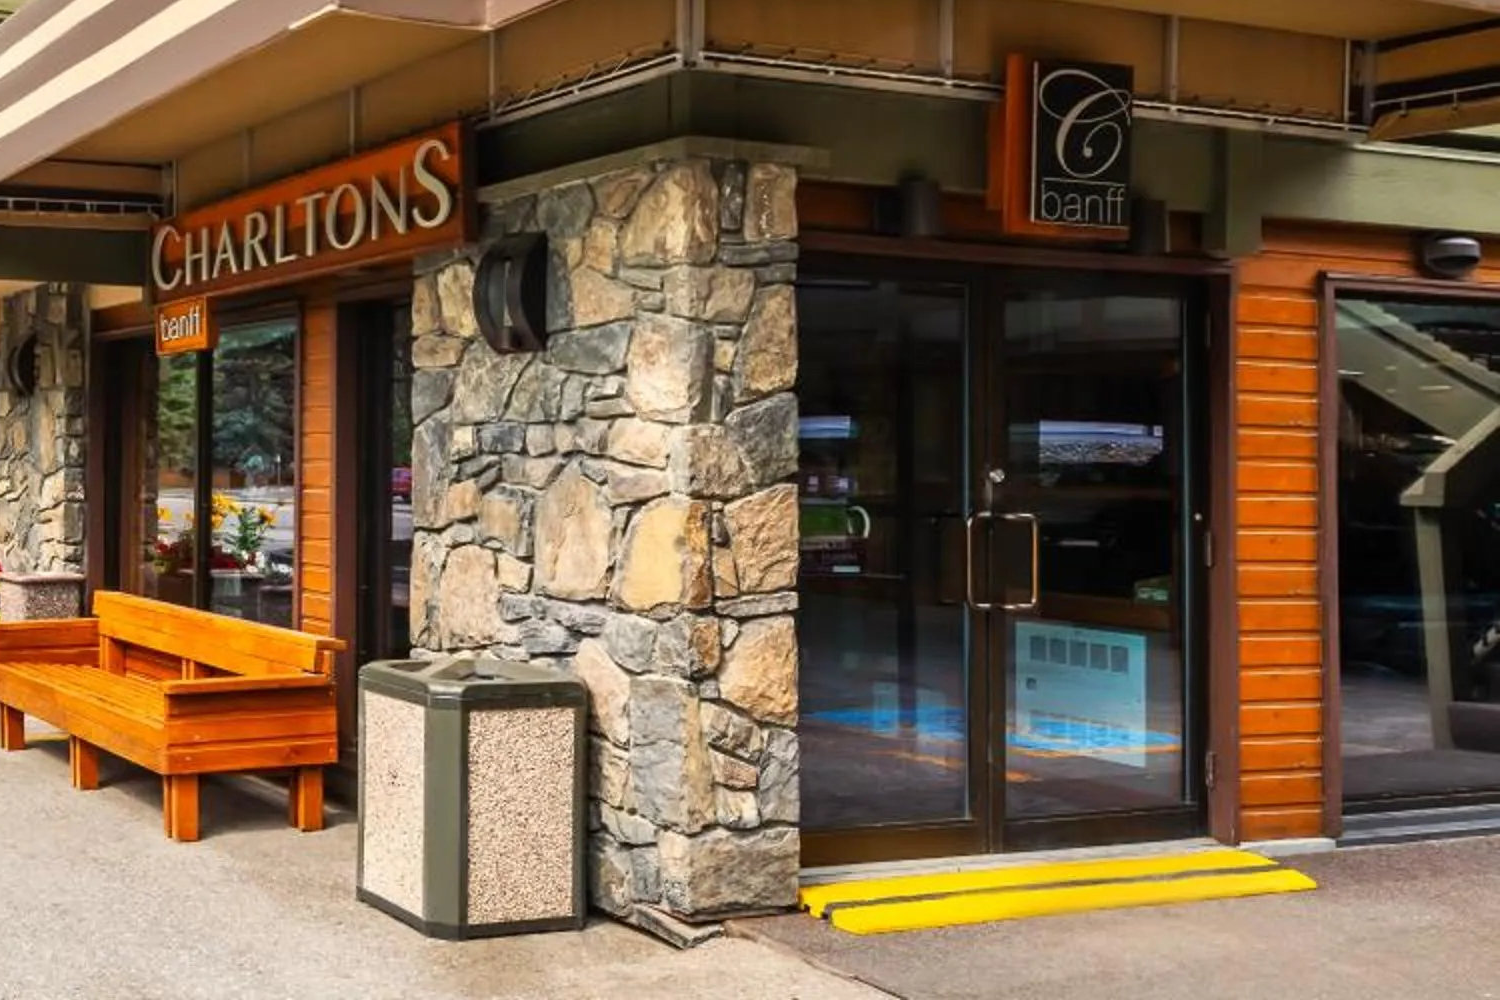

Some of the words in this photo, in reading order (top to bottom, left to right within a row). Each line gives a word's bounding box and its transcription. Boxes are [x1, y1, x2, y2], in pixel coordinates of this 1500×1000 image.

[151, 139, 451, 290] CHARLTONS
[1041, 184, 1125, 224] banff
[160, 304, 200, 341] banff
